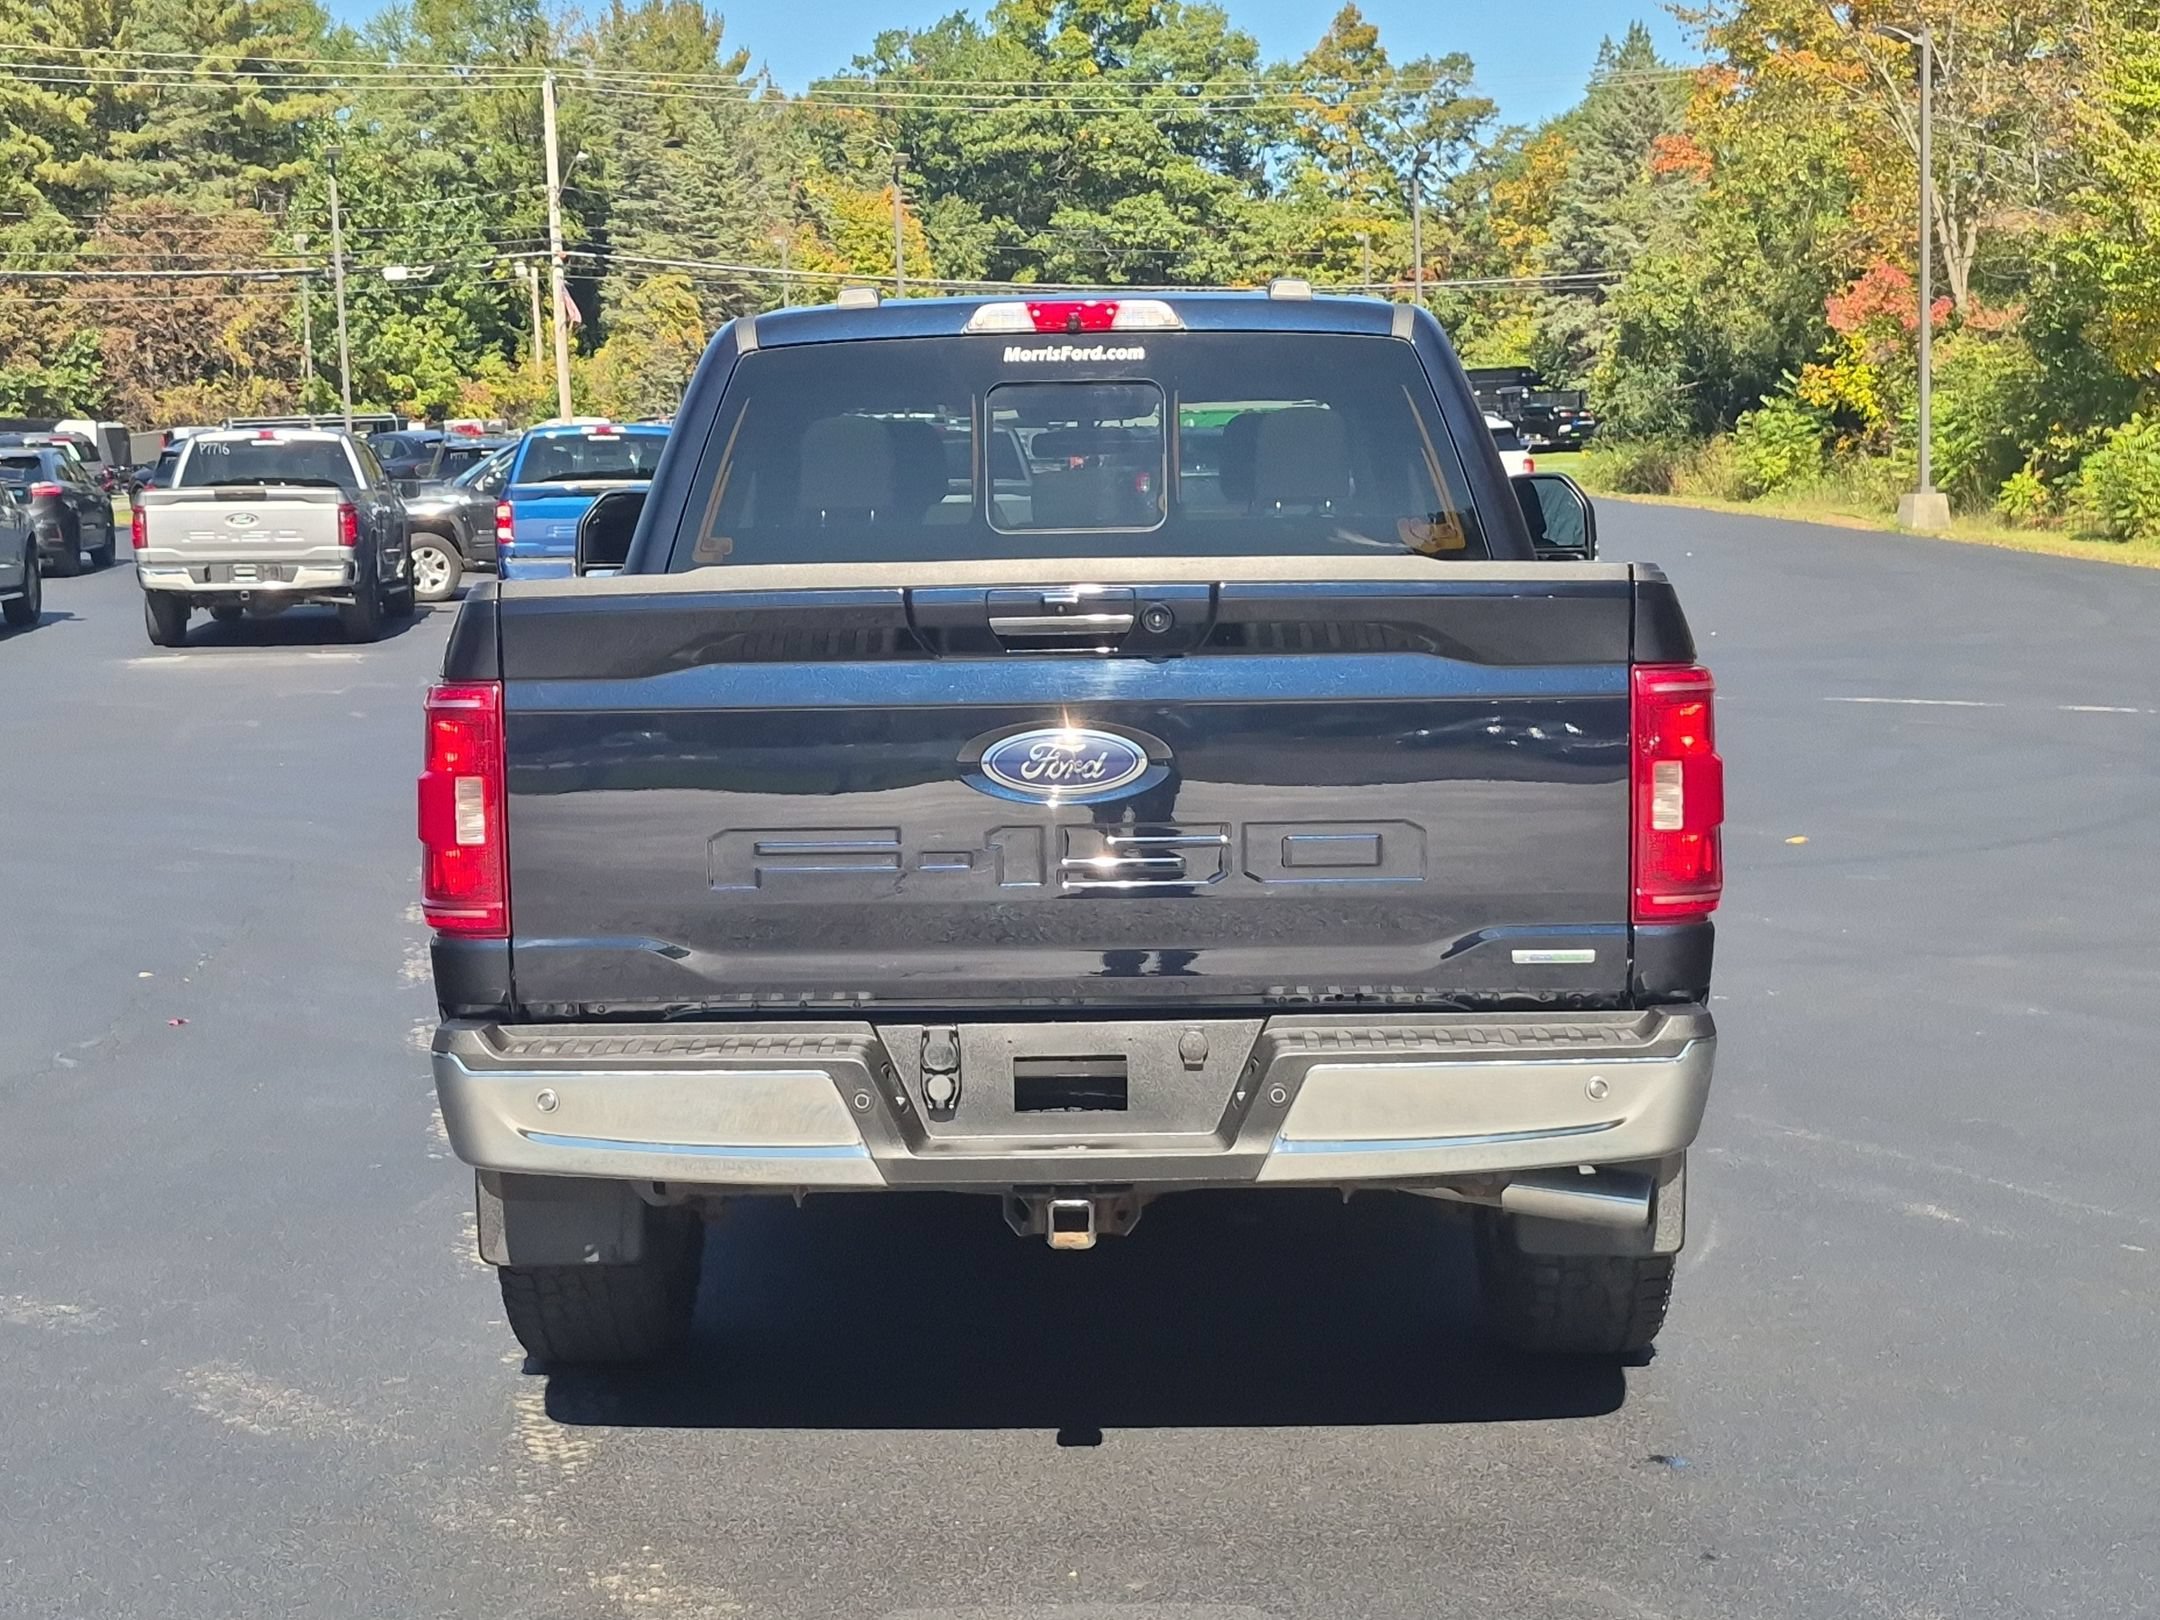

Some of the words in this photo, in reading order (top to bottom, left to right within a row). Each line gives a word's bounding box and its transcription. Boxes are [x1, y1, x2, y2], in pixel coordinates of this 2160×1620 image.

[1003, 345, 1146, 363] MorrisFord.com
[198, 442, 231, 456] P7716
[1020, 742, 1108, 780] Ford
[706, 822, 1429, 892] F-150
